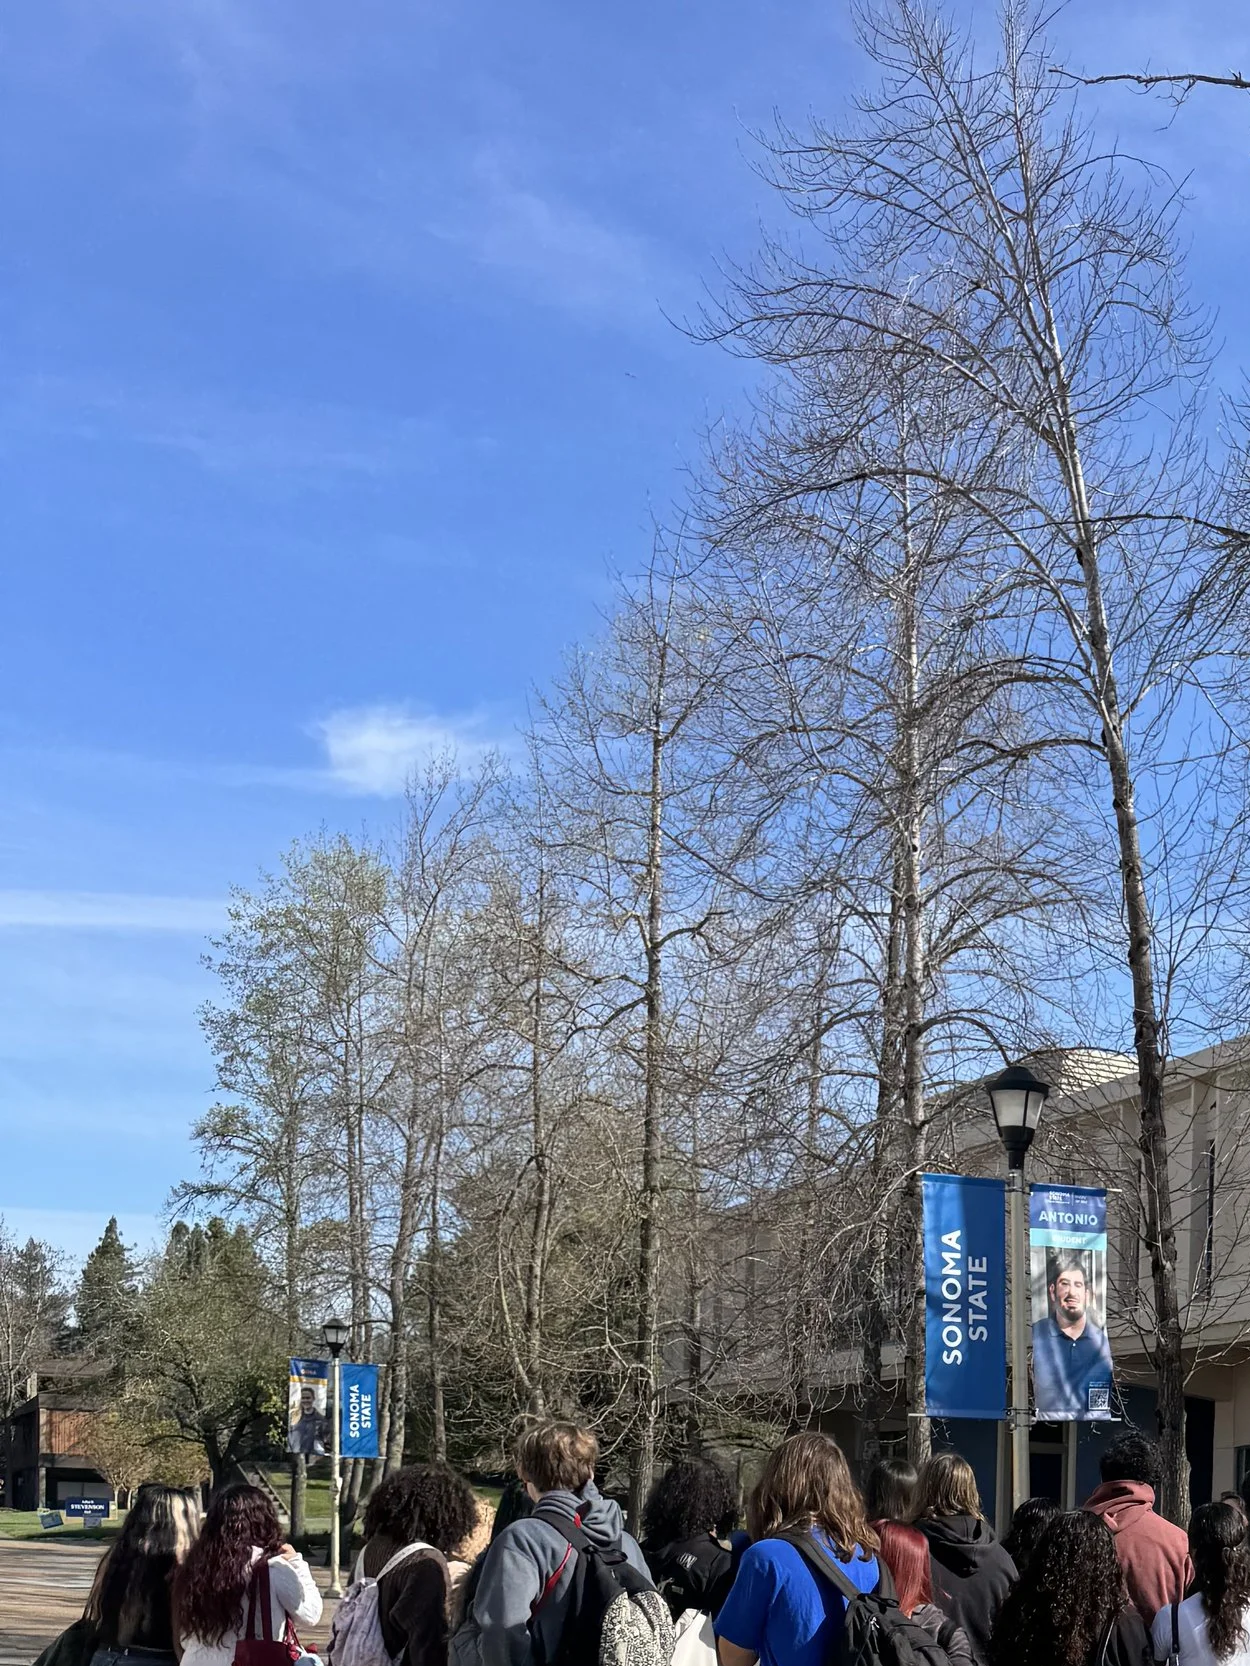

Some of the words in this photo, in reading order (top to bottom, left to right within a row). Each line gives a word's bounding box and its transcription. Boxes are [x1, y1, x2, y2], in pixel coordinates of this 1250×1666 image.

[1039, 1210, 1098, 1226] ANTONIO
[941, 1230, 962, 1365] SONOMA
[968, 1256, 988, 1342] STATE
[349, 1384, 360, 1438] SONOMA
[361, 1394, 371, 1428] STATE
